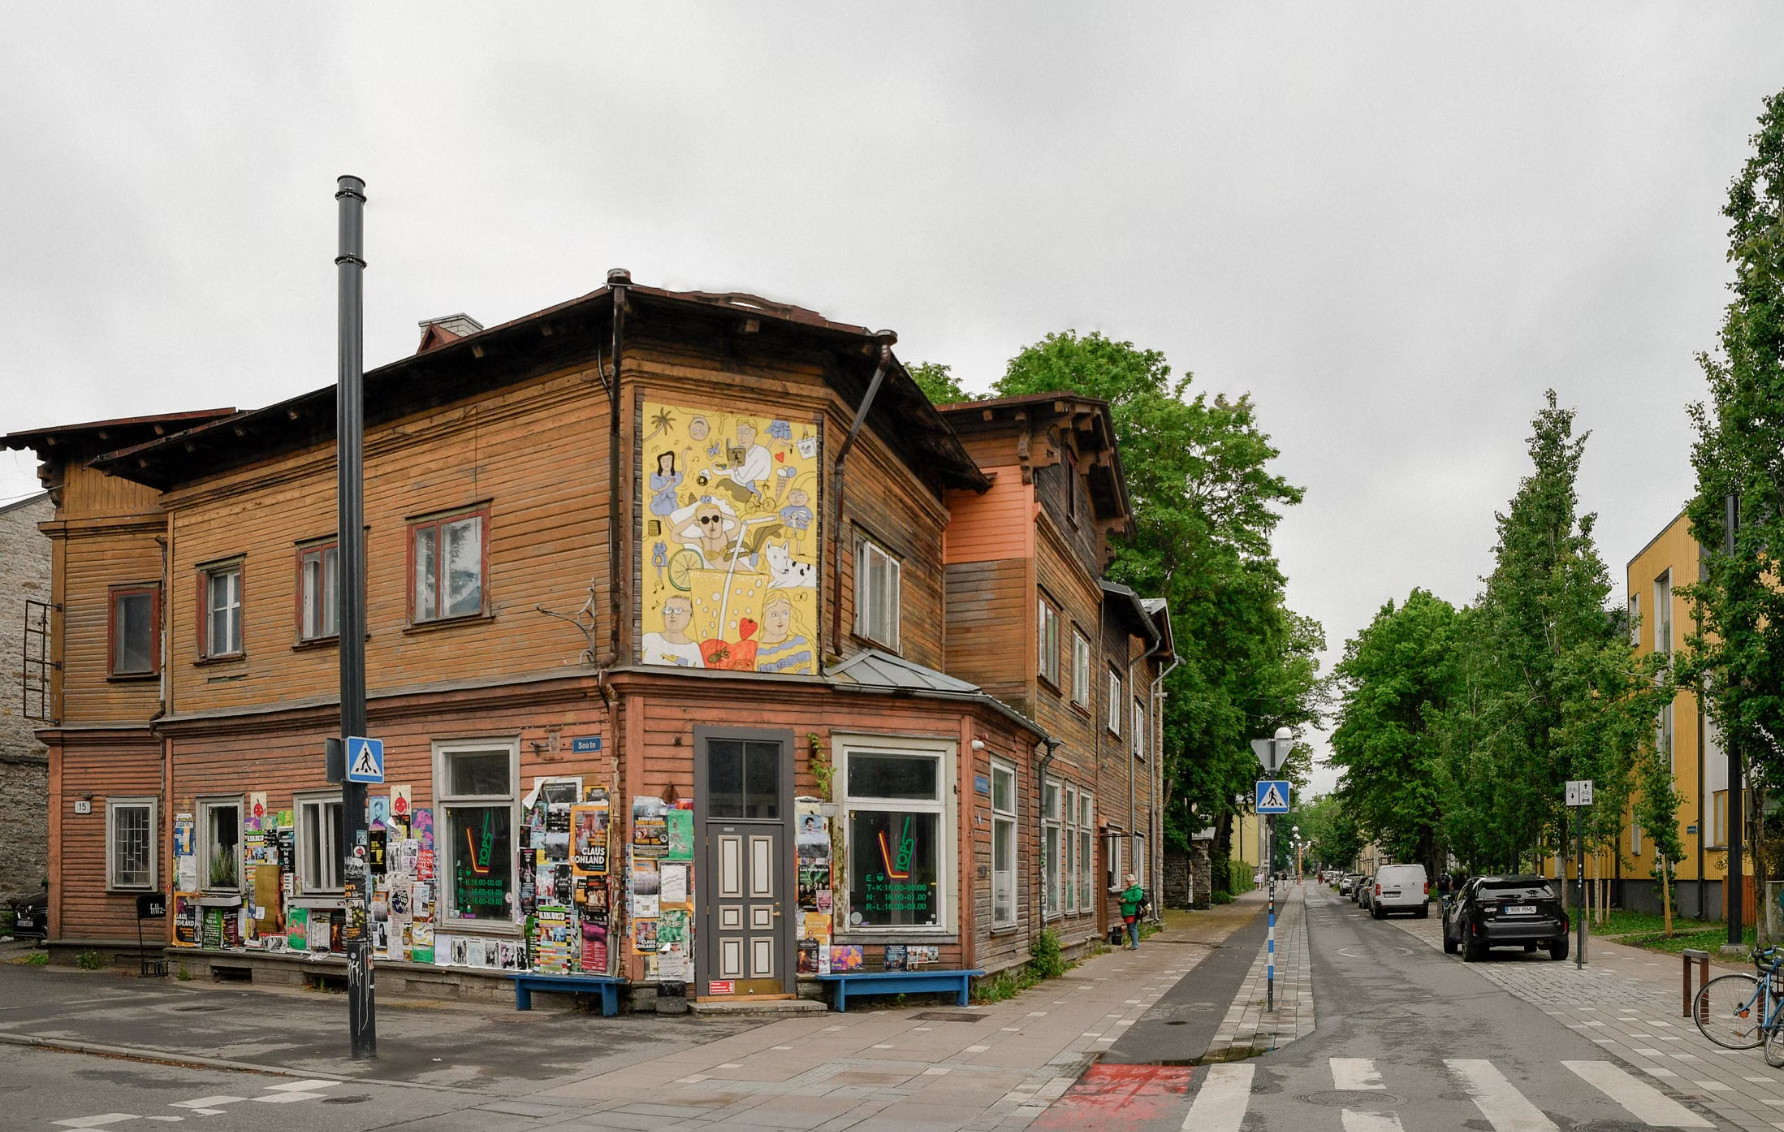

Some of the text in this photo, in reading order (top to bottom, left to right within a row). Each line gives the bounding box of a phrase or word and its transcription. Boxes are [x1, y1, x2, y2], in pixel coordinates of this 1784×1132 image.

[79, 802, 86, 811] 15
[581, 847, 605, 855] CLAUS
[895, 829, 915, 871] TOPS
[570, 855, 604, 864] ROHLAND
